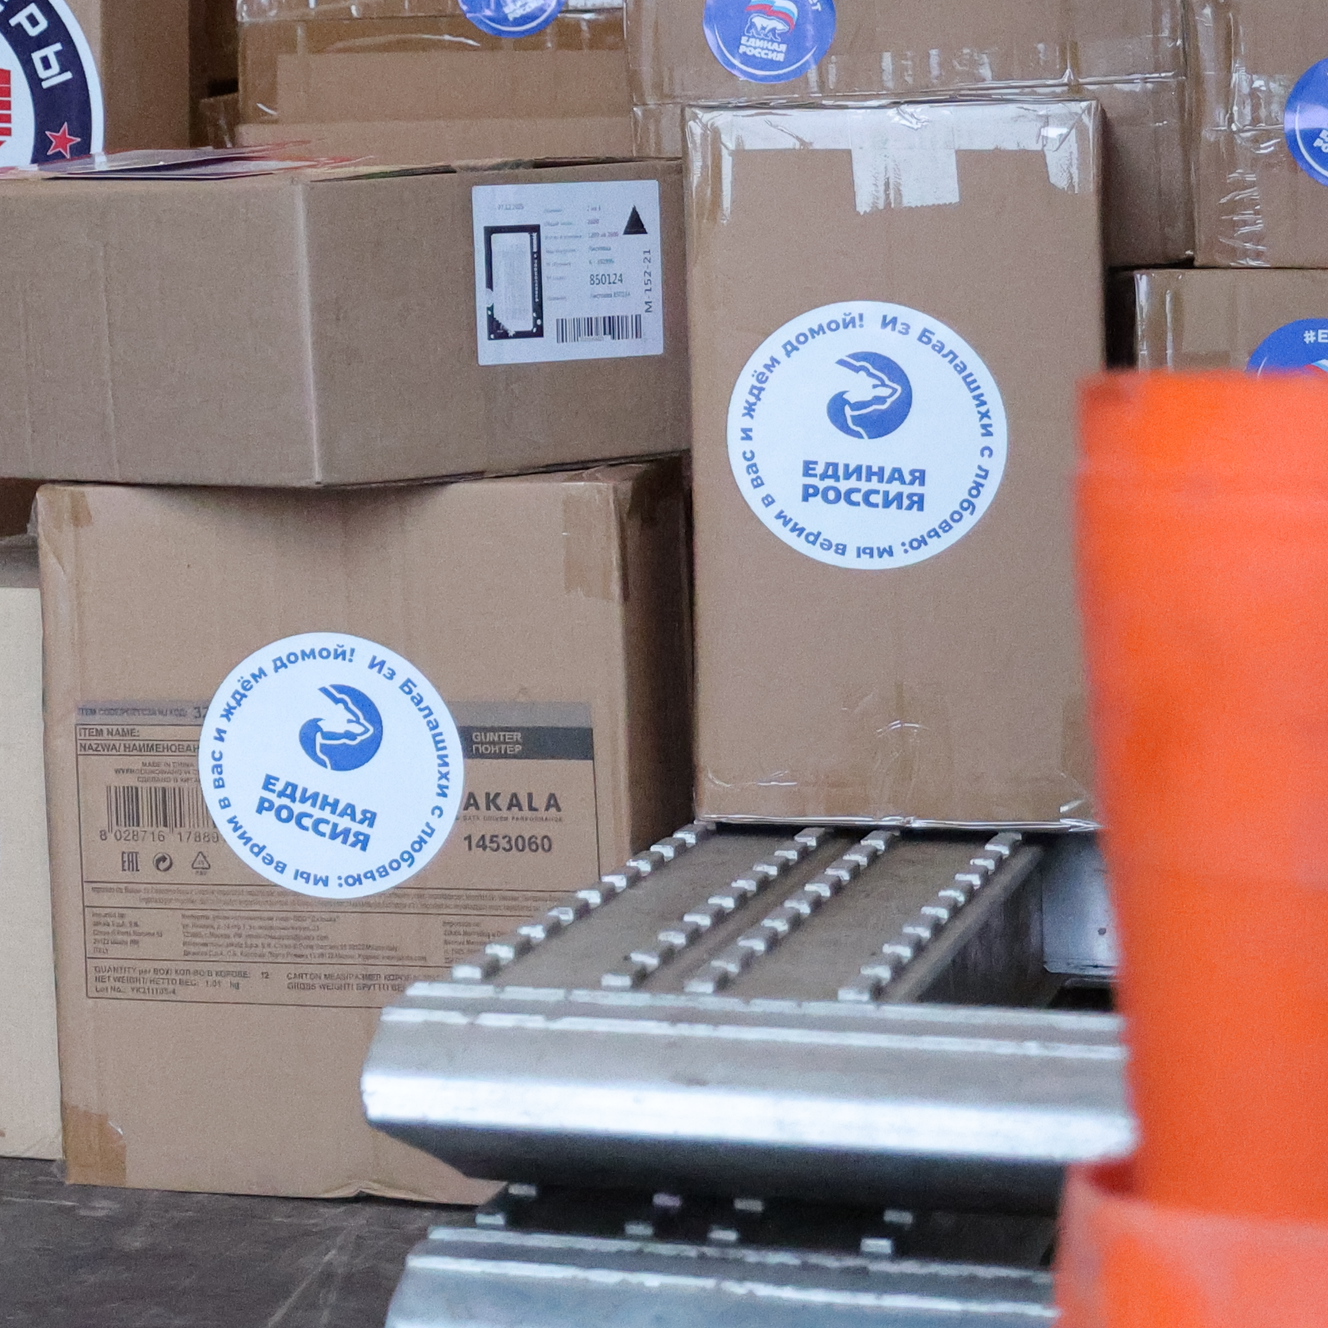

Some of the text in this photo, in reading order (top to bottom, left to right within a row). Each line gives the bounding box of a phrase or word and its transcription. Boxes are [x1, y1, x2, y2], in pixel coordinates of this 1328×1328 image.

[739, 45, 786, 62] РОССИЯ
[741, 36, 787, 52] ЕДИНАЯ
[589, 273, 624, 286] 850124
[642, 249, 653, 313] M-152-21
[740, 313, 994, 558] Из Балашихи с любовью: мы верим в вас и ждём домой!
[802, 460, 926, 487] ЕДИНАЯ
[801, 483, 925, 512] РОССИЯ
[79, 728, 140, 737] ITEM NAME:
[472, 732, 522, 742] GUNTER
[123, 743, 200, 753] НАИМЕНОВАН
[211, 644, 450, 887] Из Балашихи с любовью: мы верим в вас и ждём домой!
[261, 773, 377, 829] ЕДИНАЯ
[463, 792, 562, 813] AKALA
[255, 796, 371, 852] РОССИЯ
[464, 834, 553, 852] 1453060
